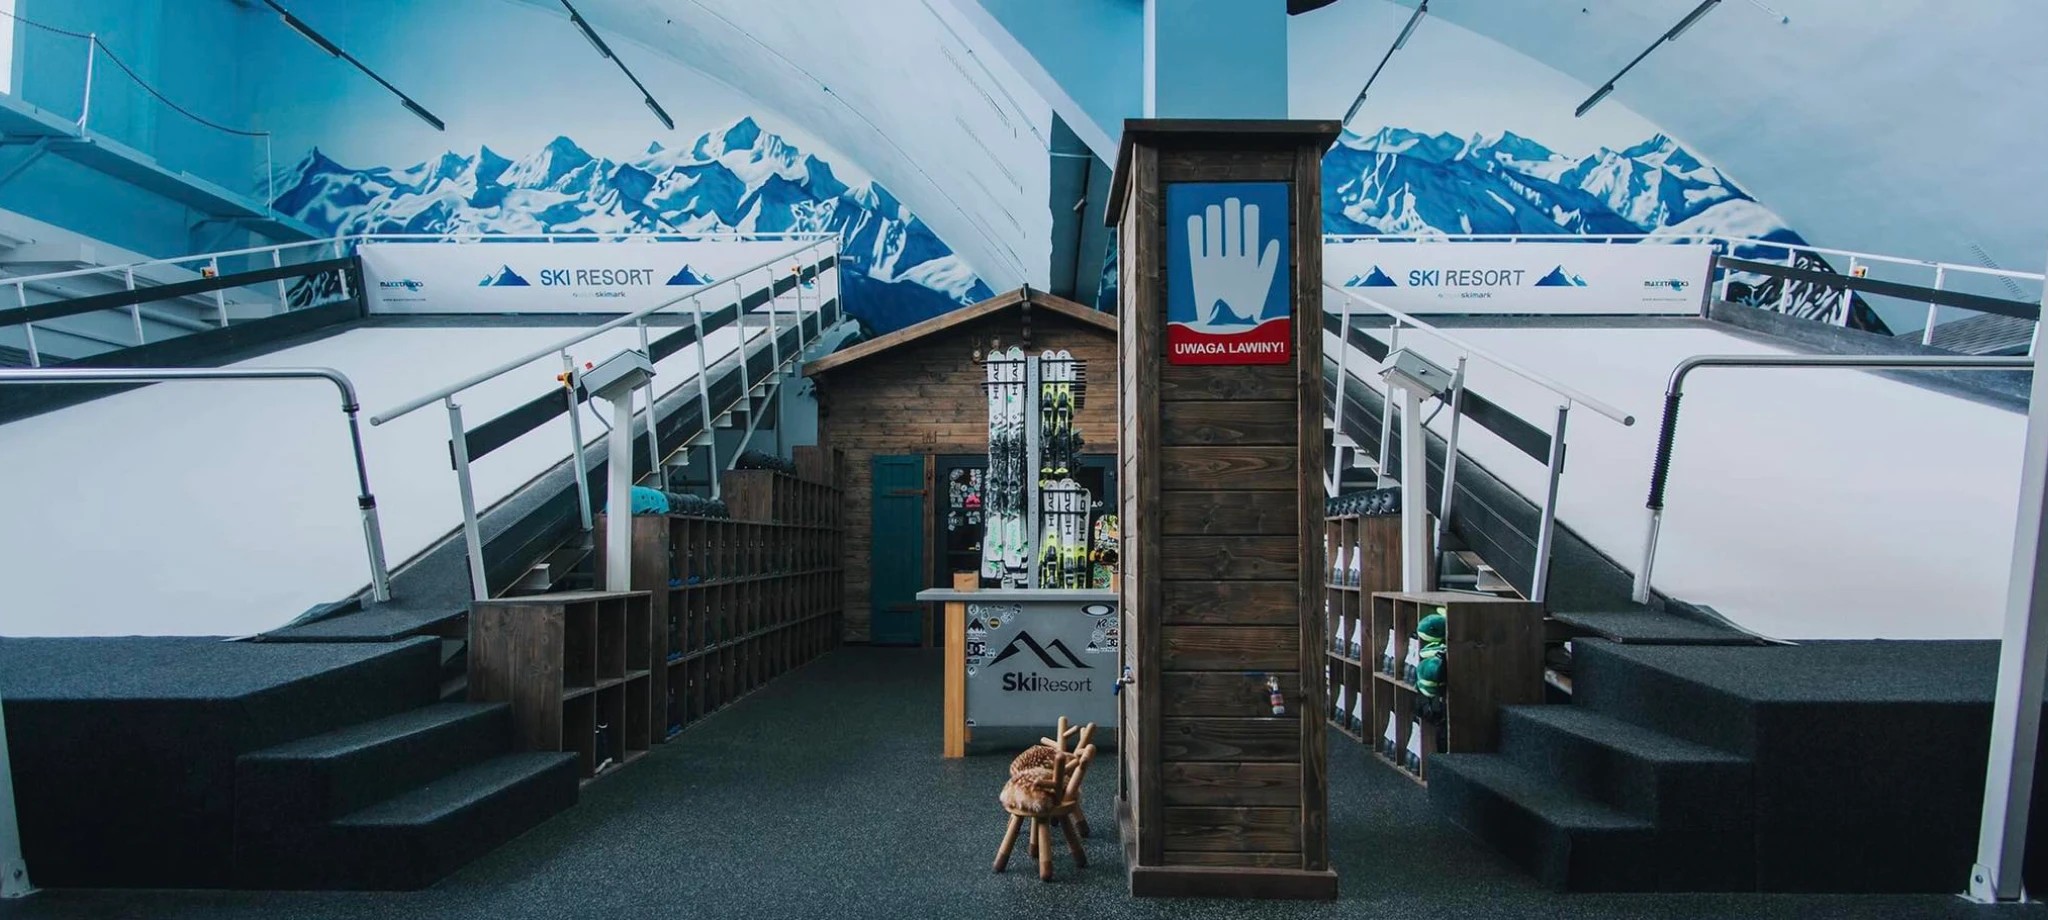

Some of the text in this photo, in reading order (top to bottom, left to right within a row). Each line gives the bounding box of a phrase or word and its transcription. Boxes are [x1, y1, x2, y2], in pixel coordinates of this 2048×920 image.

[540, 269, 654, 286] SKI RESORT
[1408, 270, 1525, 286] SKI RESORT
[1175, 342, 1284, 354] UWAGA LAWINY!
[1079, 500, 1087, 541] HEAD
[1002, 672, 1092, 692] SkiResort
